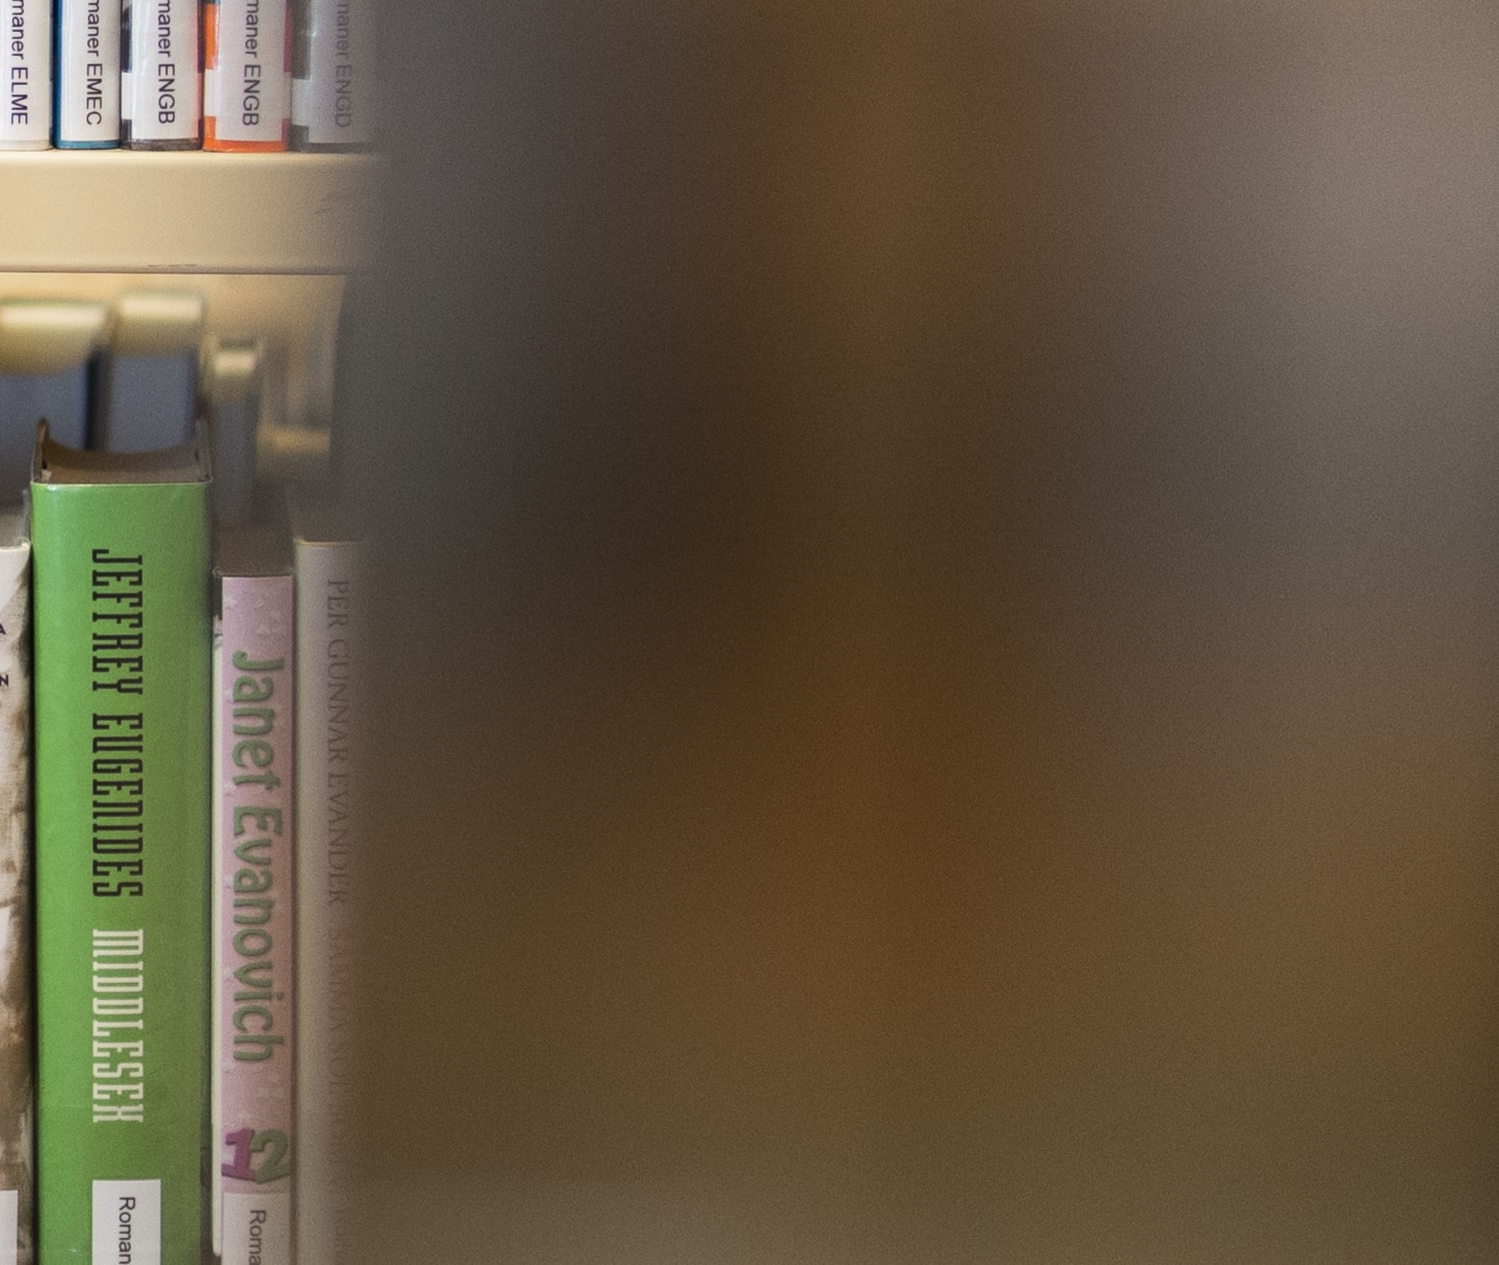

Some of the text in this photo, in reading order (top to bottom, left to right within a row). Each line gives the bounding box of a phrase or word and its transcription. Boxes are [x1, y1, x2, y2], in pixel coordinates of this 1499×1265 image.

[86, 63, 102, 125] EMEC
[92, 549, 144, 1123] JEFFREY EUGENIDES MIDDLESEX
[231, 651, 286, 1062] Janet Evanovich
